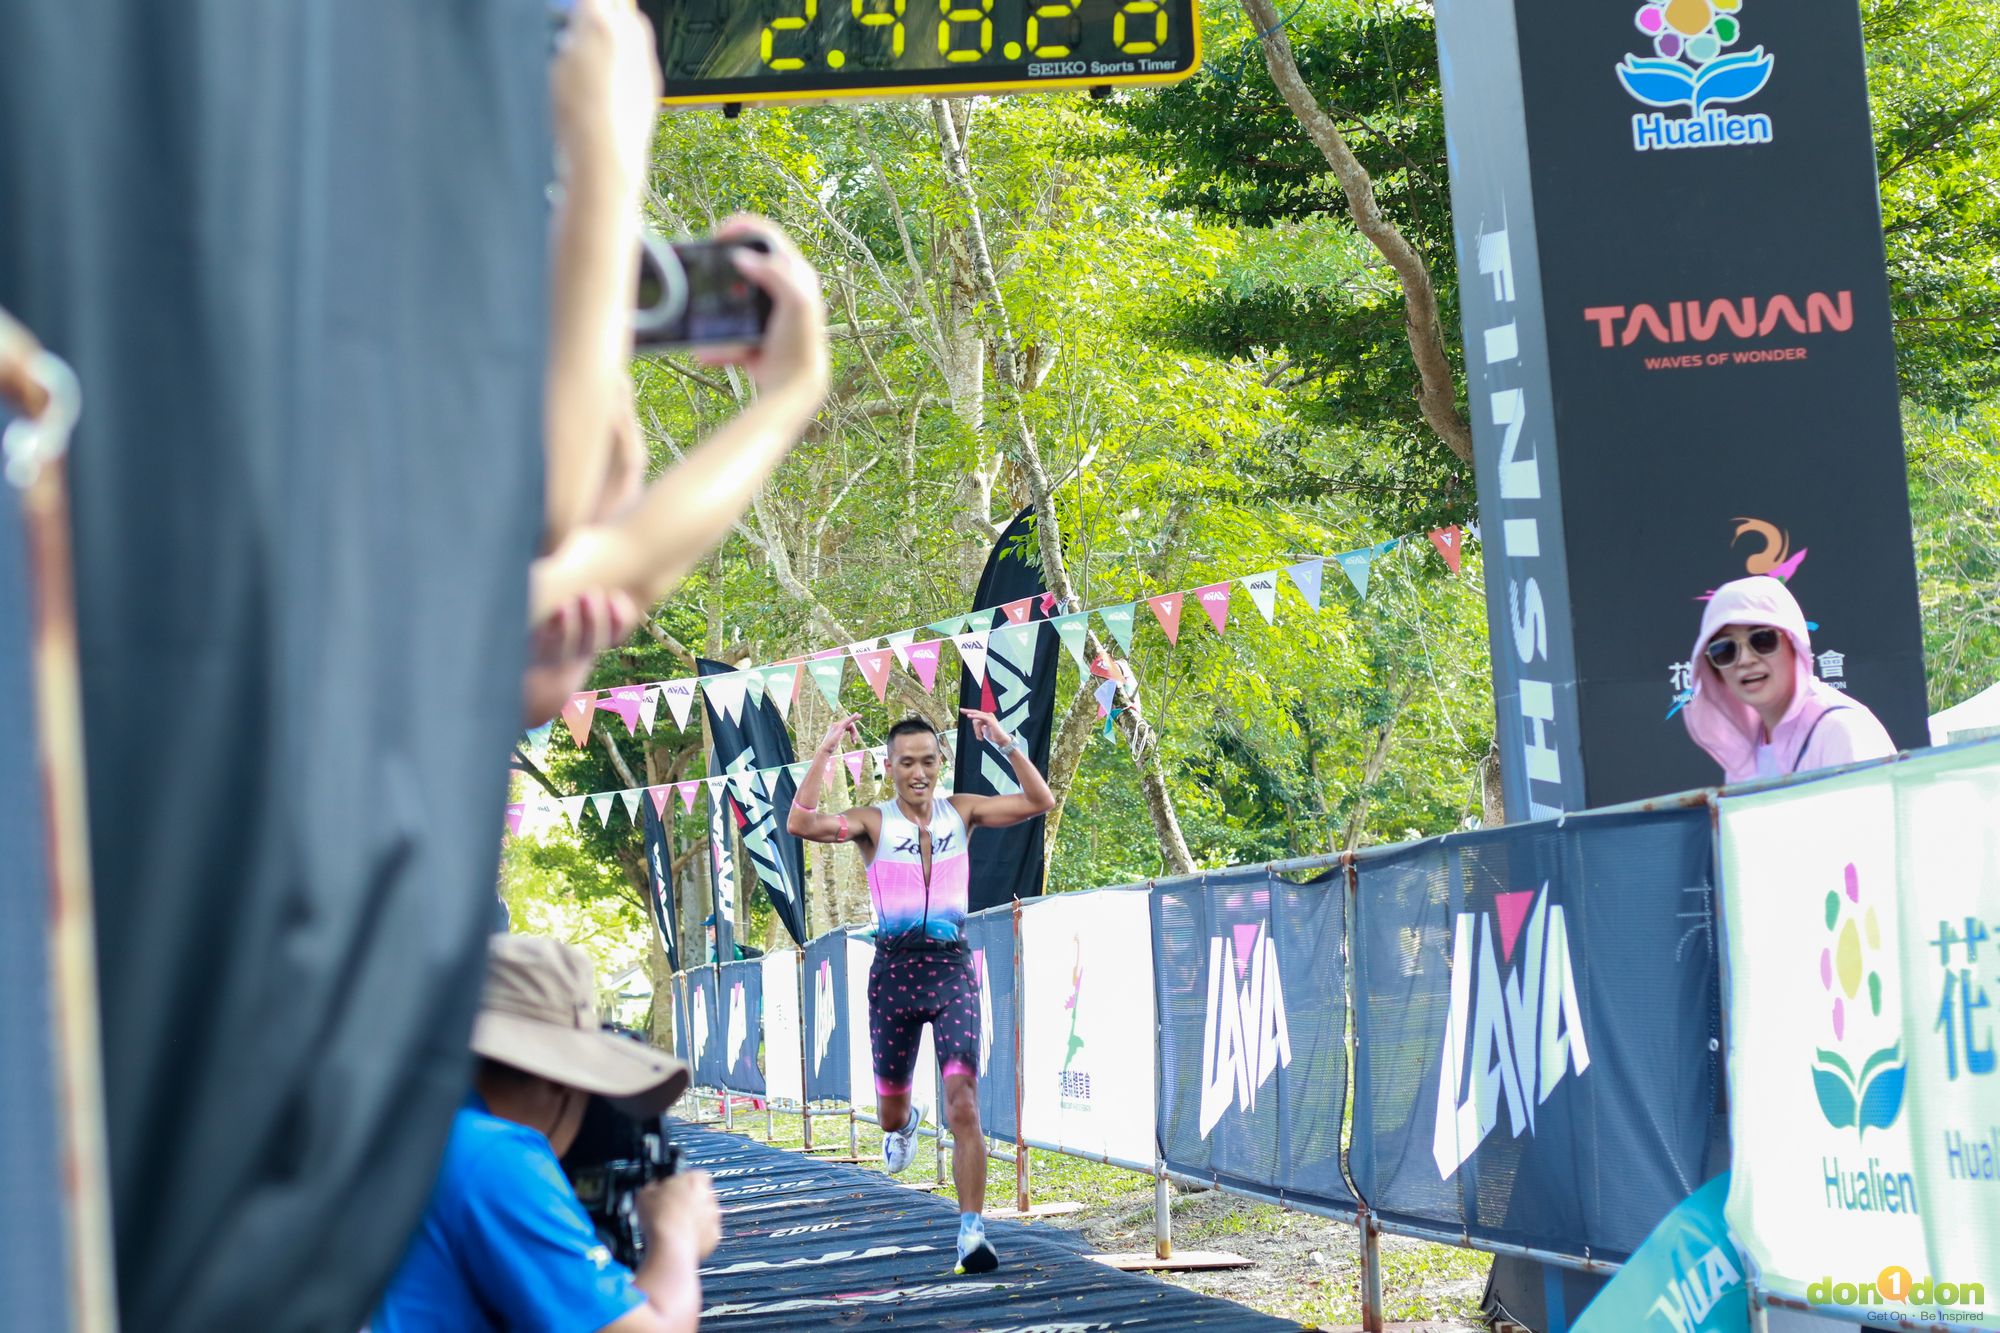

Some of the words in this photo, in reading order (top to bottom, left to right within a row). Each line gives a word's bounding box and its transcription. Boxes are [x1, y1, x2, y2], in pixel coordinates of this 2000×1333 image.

[1027, 61, 1086, 77] SEIKO
[1090, 61, 1134, 74] Sports
[1138, 59, 1177, 71] Timer
[1633, 111, 1773, 150] Hualien
[1584, 290, 1854, 348] TAIWAN
[1644, 354, 1703, 370] WAVES
[1706, 352, 1729, 366] OF
[1732, 347, 1808, 364] WONDER
[1200, 919, 1292, 1141] LAVA
[1433, 880, 1591, 1181] LAVA
[1822, 1156, 1919, 1215] Hualien
